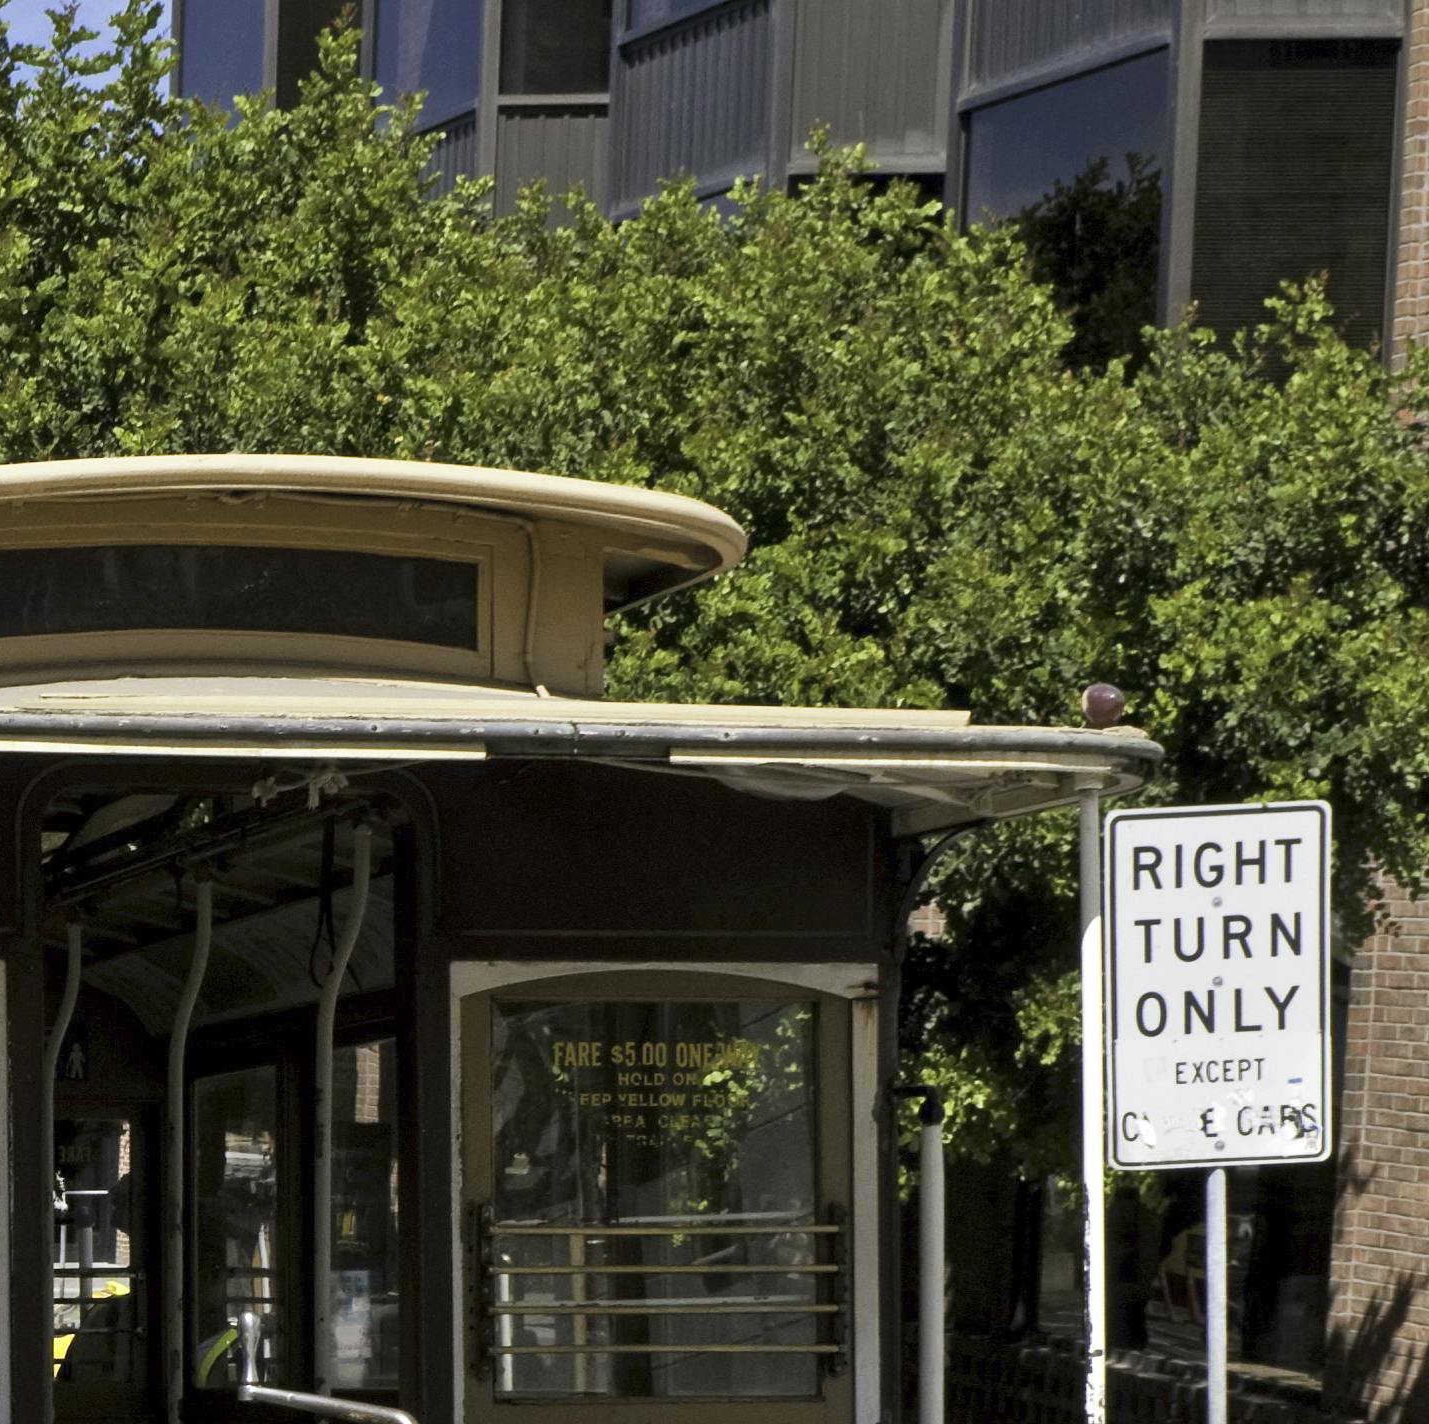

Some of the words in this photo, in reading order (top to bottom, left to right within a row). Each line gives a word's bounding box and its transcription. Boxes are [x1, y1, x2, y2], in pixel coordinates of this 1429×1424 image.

[1133, 838, 1302, 891] RIGHT
[1134, 912, 1302, 964] TURN
[1136, 985, 1300, 1038] ONLY
[552, 1041, 602, 1068] FARE
[676, 1041, 713, 1068] ONE
[617, 1072, 666, 1086] HOLD
[1175, 1058, 1266, 1085] EXCEPT
[578, 1093, 613, 1107] EEP
[617, 1093, 686, 1107] YELLOW
